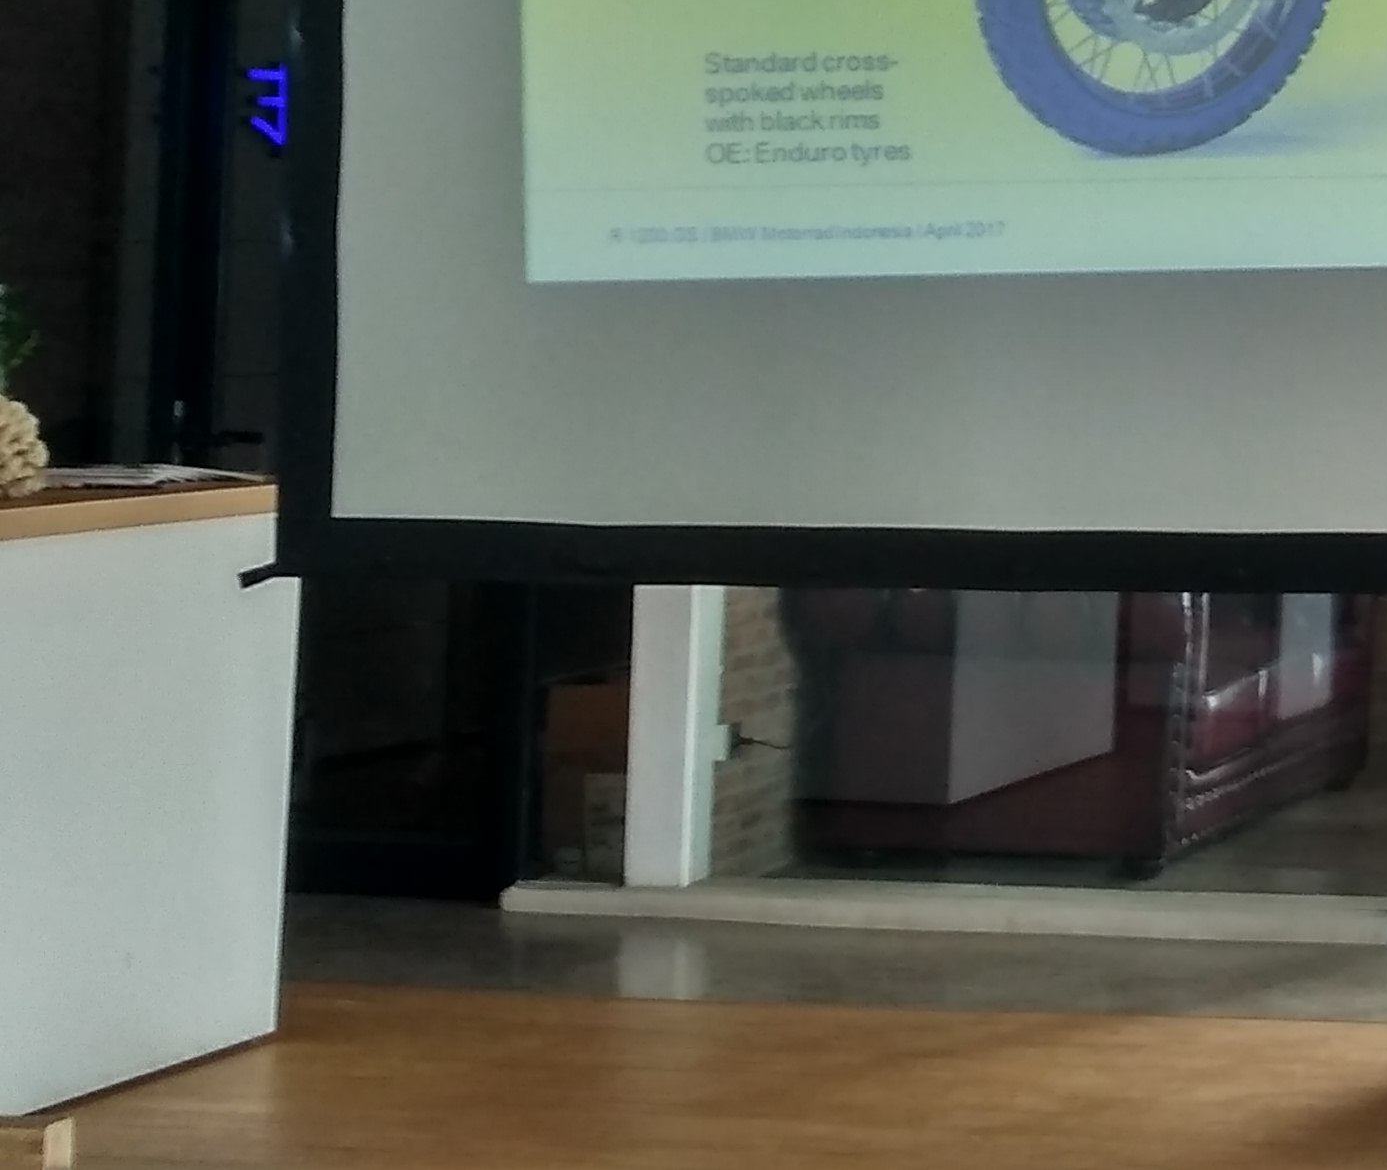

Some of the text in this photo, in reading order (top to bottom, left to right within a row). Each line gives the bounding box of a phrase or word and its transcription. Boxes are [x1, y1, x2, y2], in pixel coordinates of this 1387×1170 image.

[704, 51, 900, 75] Standard cross-
[704, 80, 885, 108] spoked wheels
[704, 110, 881, 133] with black rims
[705, 140, 913, 168] OE: Enduro tyres
